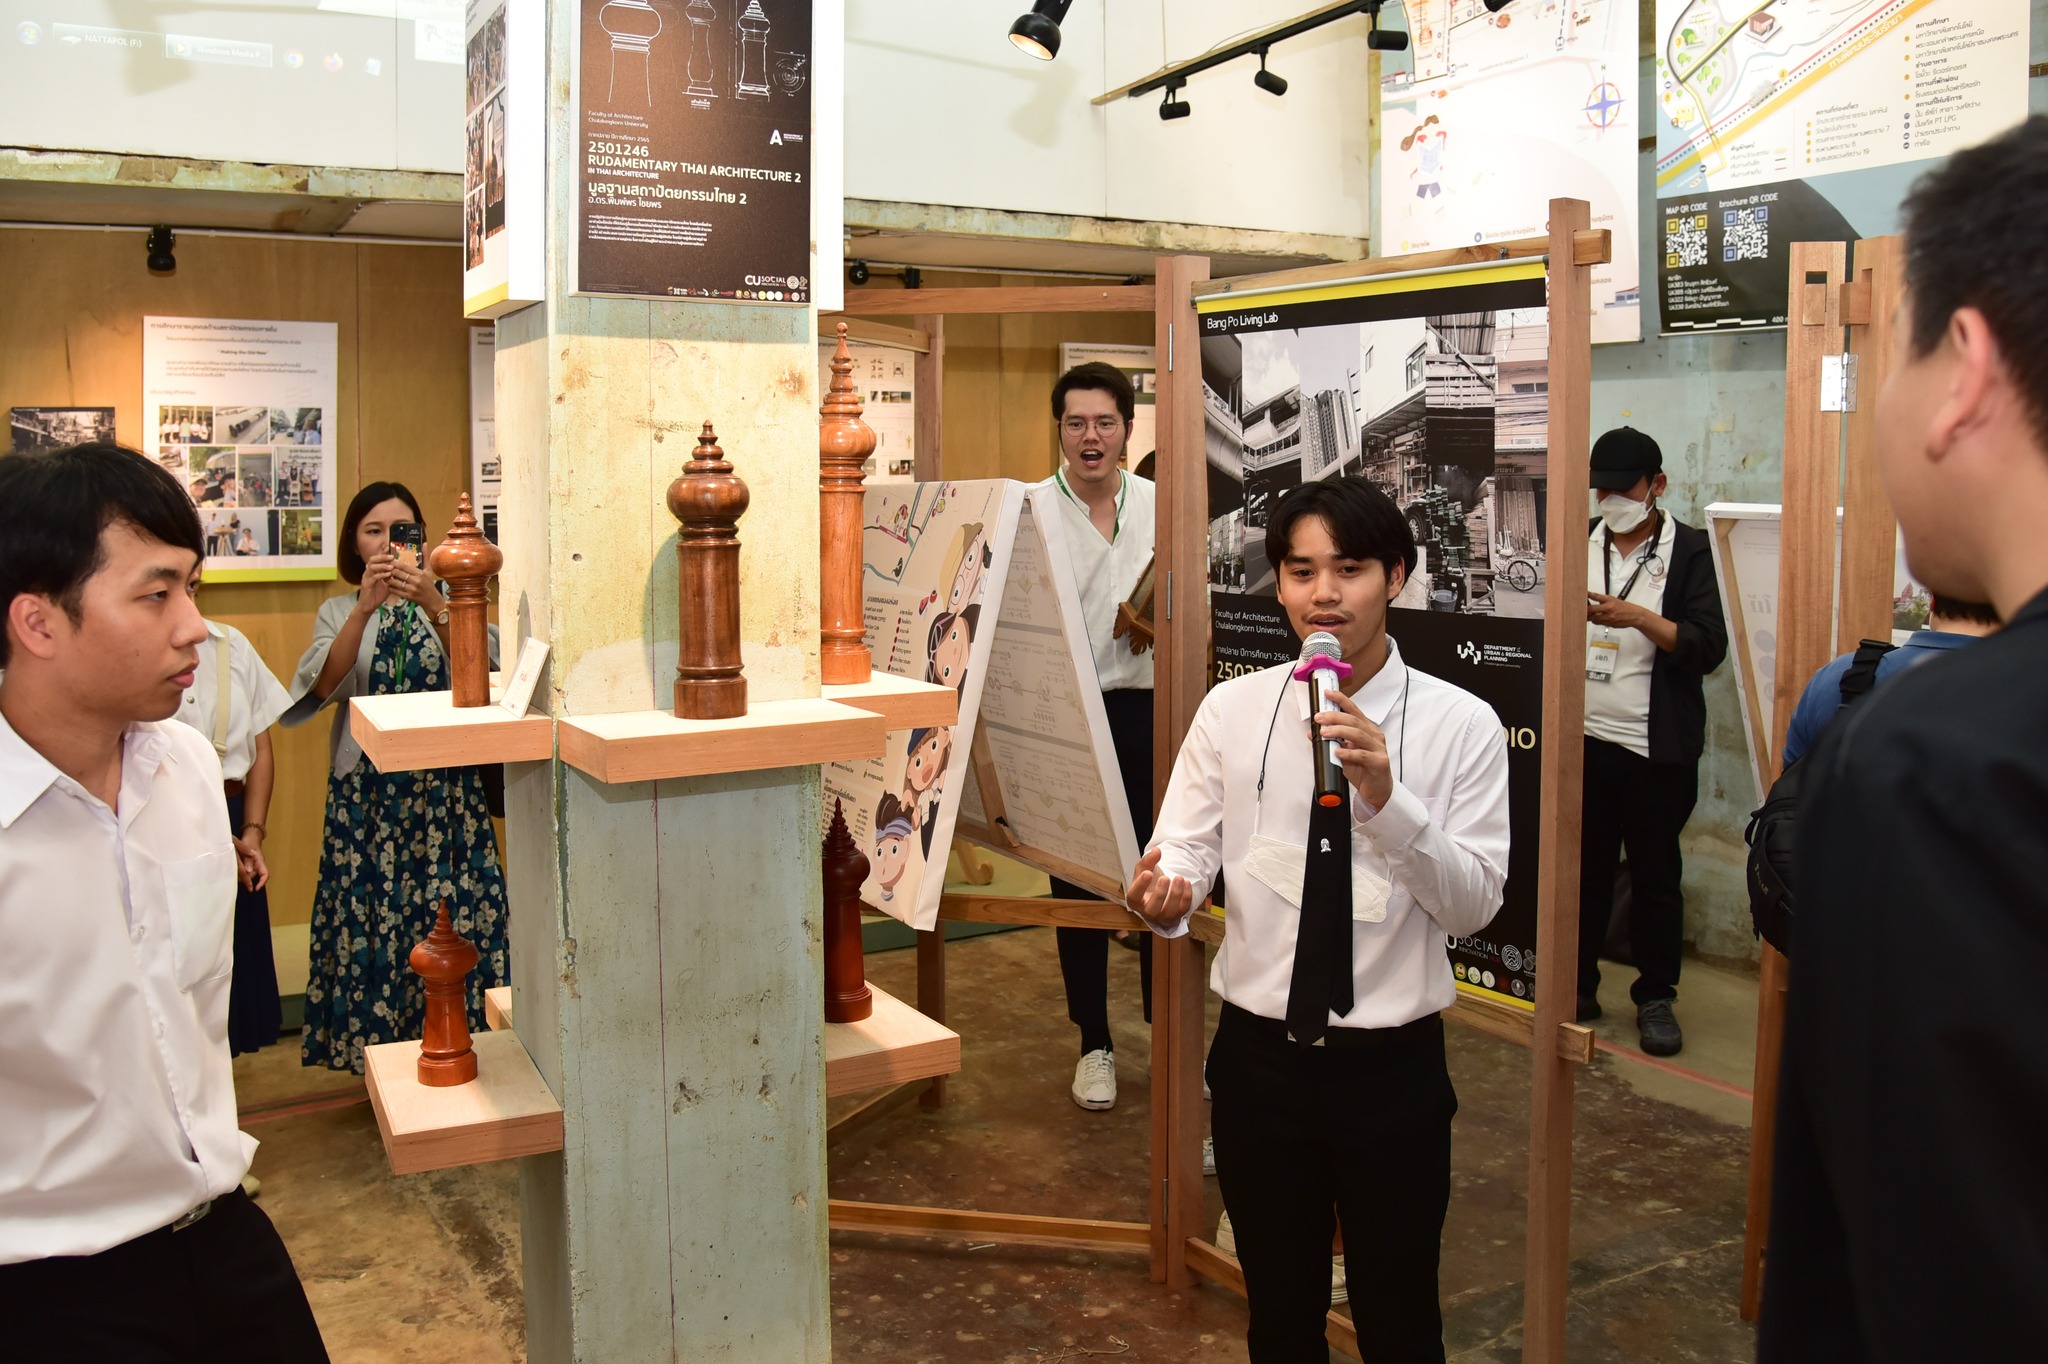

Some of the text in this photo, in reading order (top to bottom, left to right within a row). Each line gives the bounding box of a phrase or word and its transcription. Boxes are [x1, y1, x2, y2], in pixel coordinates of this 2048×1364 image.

[84, 34, 128, 46] NATTAPOL
[588, 110, 606, 118] Faculty
[1944, 114, 1956, 122] LPG
[588, 118, 624, 126] Chulalongkorn
[770, 129, 783, 146] A
[588, 141, 649, 157] 2501246
[588, 154, 802, 183] RUDAMENTARY THAI ARCHITECTURE 2
[596, 168, 612, 176] THAI
[612, 170, 660, 180] ARCHITECTURE
[588, 182, 747, 204] มูลฐานสถาปัตยกรรมไทย 2
[1718, 192, 1778, 208] brochure QR CODE
[1666, 202, 1708, 215] MAP QR CODE
[744, 274, 786, 286] CU SOCIAL
[1207, 312, 1278, 331] Bang Po Living Lab
[1215, 608, 1234, 620] Faculty
[1242, 612, 1280, 623] Architecture
[1215, 620, 1288, 638] Chulalongkorn University
[1216, 646, 1290, 662] ภาคปลาย ปีการศึกษา 2565
[1484, 644, 1516, 652] DEPARTMENT
[1588, 672, 1606, 680] Staff
[1458, 946, 1488, 960] INNOVATION
